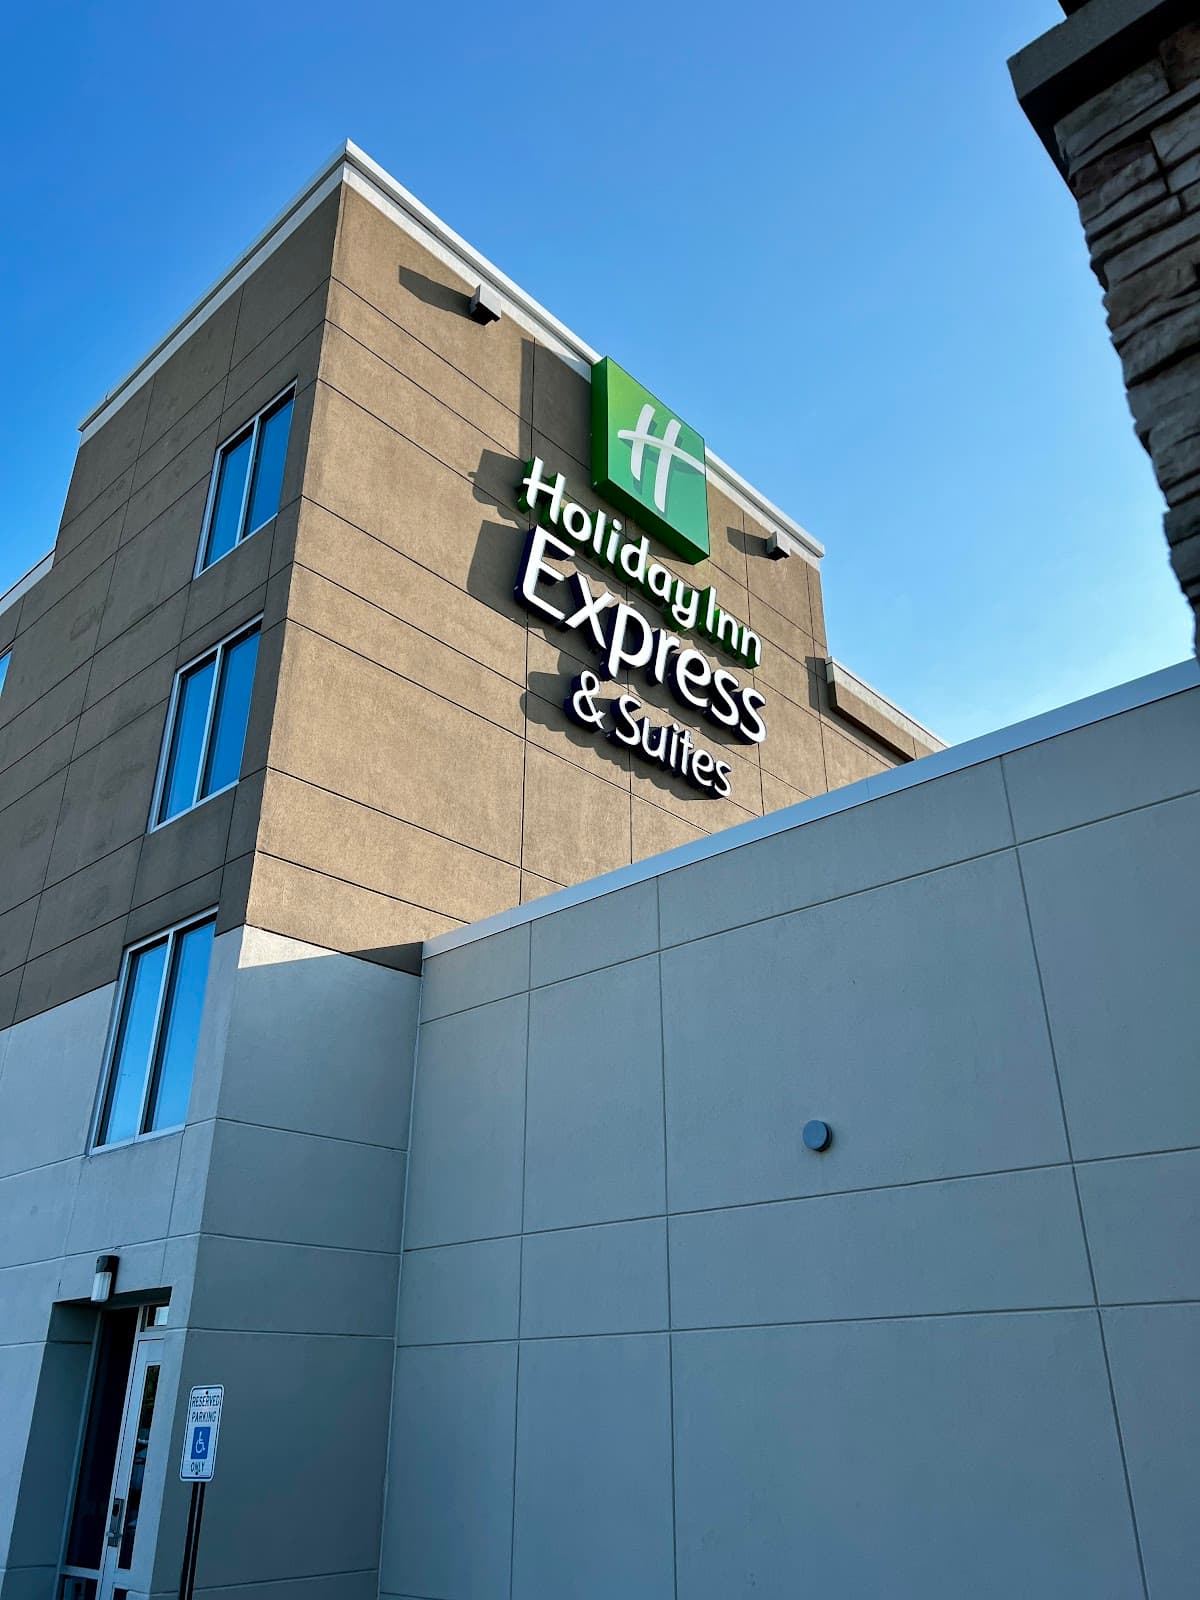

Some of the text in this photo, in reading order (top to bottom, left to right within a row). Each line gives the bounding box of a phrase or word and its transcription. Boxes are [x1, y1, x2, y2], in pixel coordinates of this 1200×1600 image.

[522, 456, 762, 668] Holiday Inn
[521, 526, 767, 744] Express
[571, 670, 732, 798] & Suites
[191, 1395, 220, 1408] RESERVED
[191, 1411, 217, 1423] PARKING
[190, 1461, 206, 1473] ONLY
